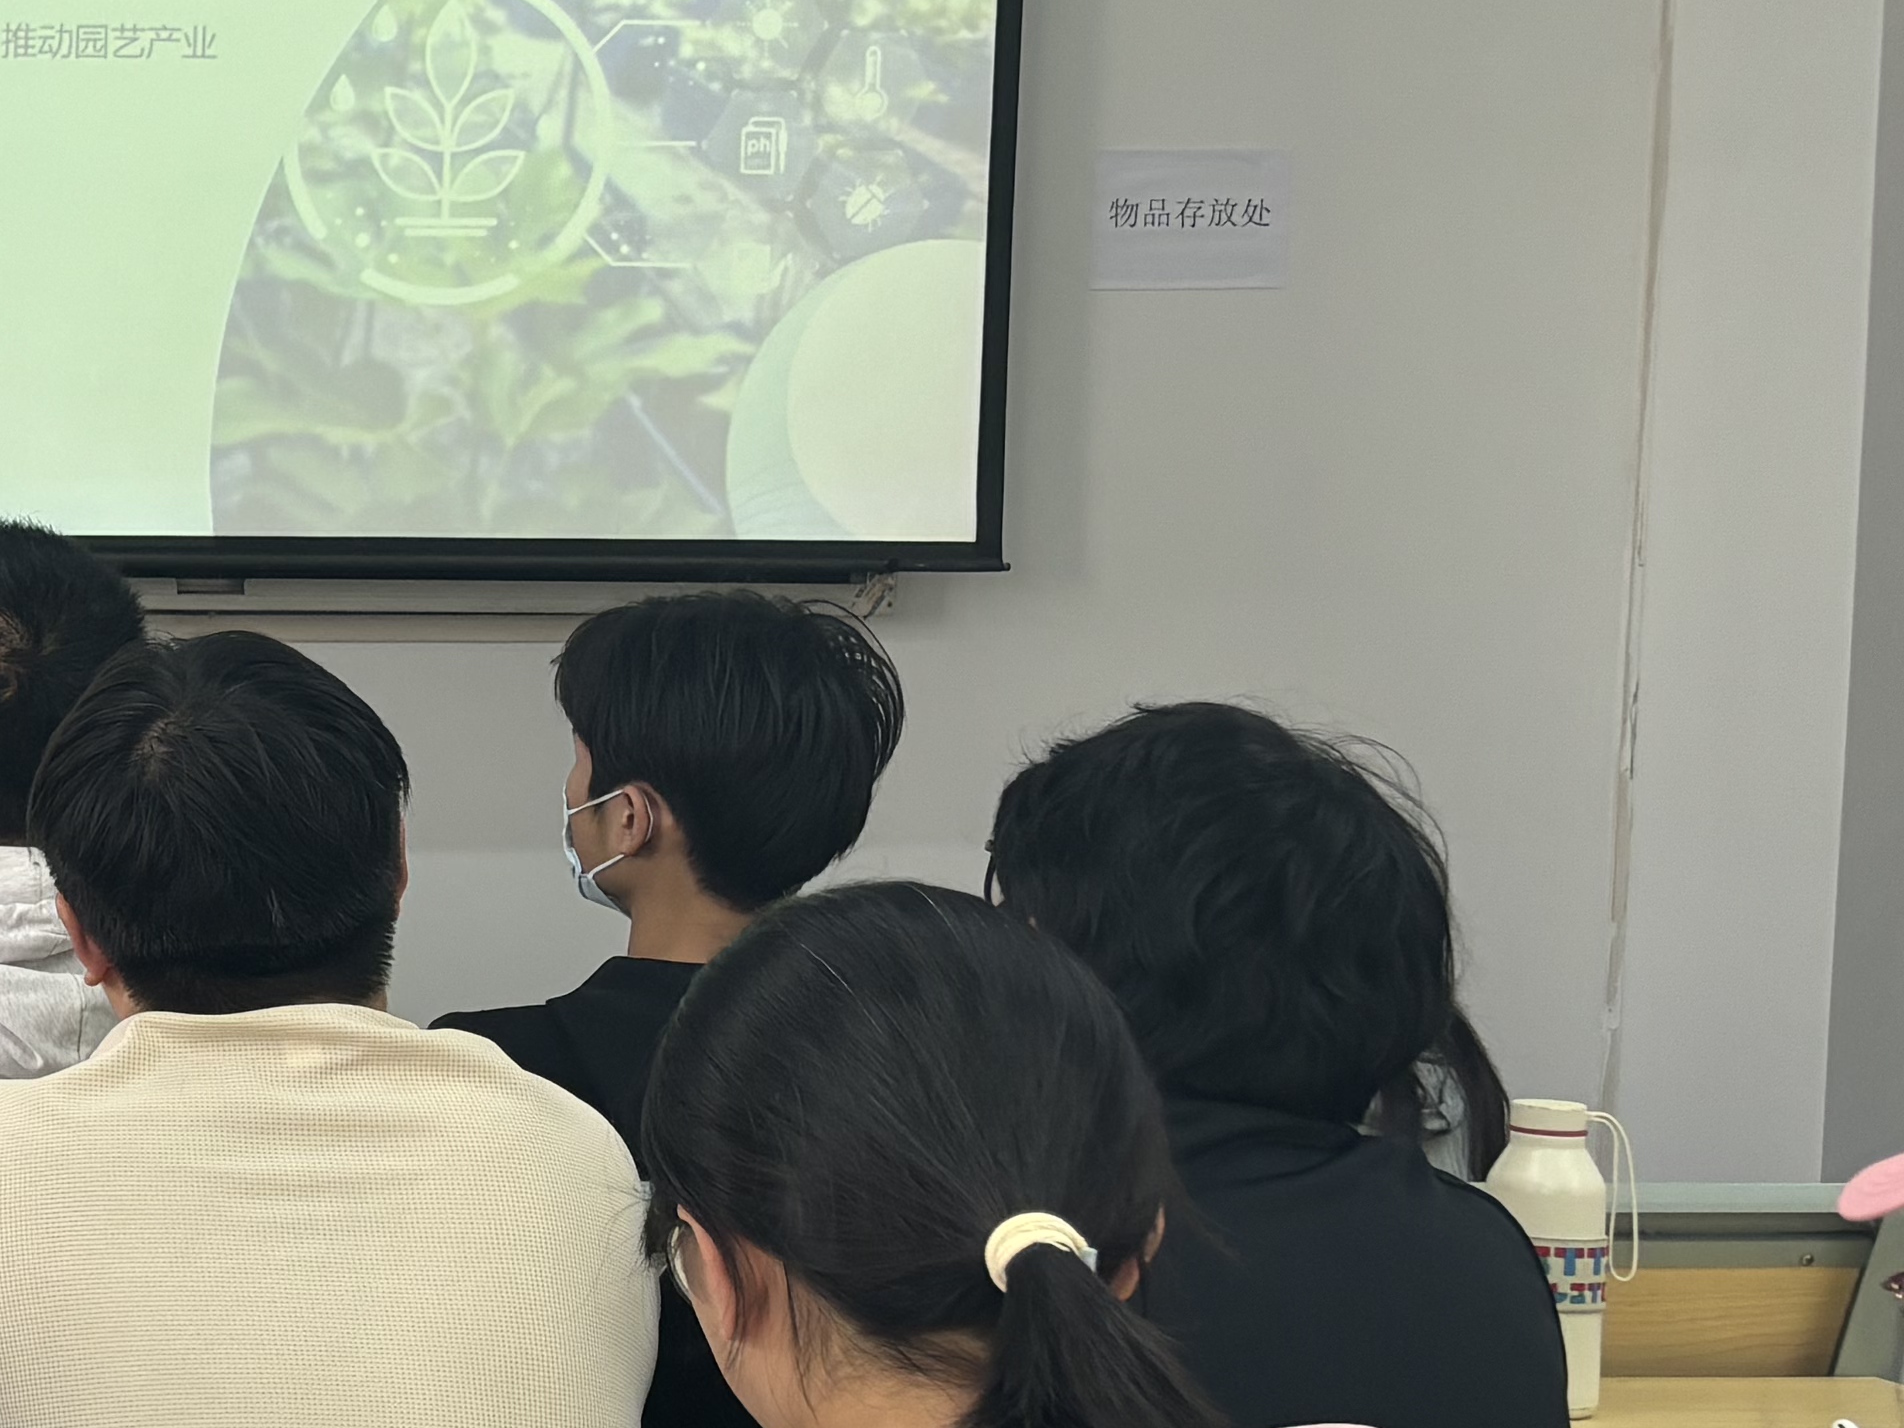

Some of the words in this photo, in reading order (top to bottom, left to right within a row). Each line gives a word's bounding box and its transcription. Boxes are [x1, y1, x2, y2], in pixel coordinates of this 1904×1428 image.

[746, 135, 771, 155] ph
[1108, 197, 1272, 230] 物品存放处
